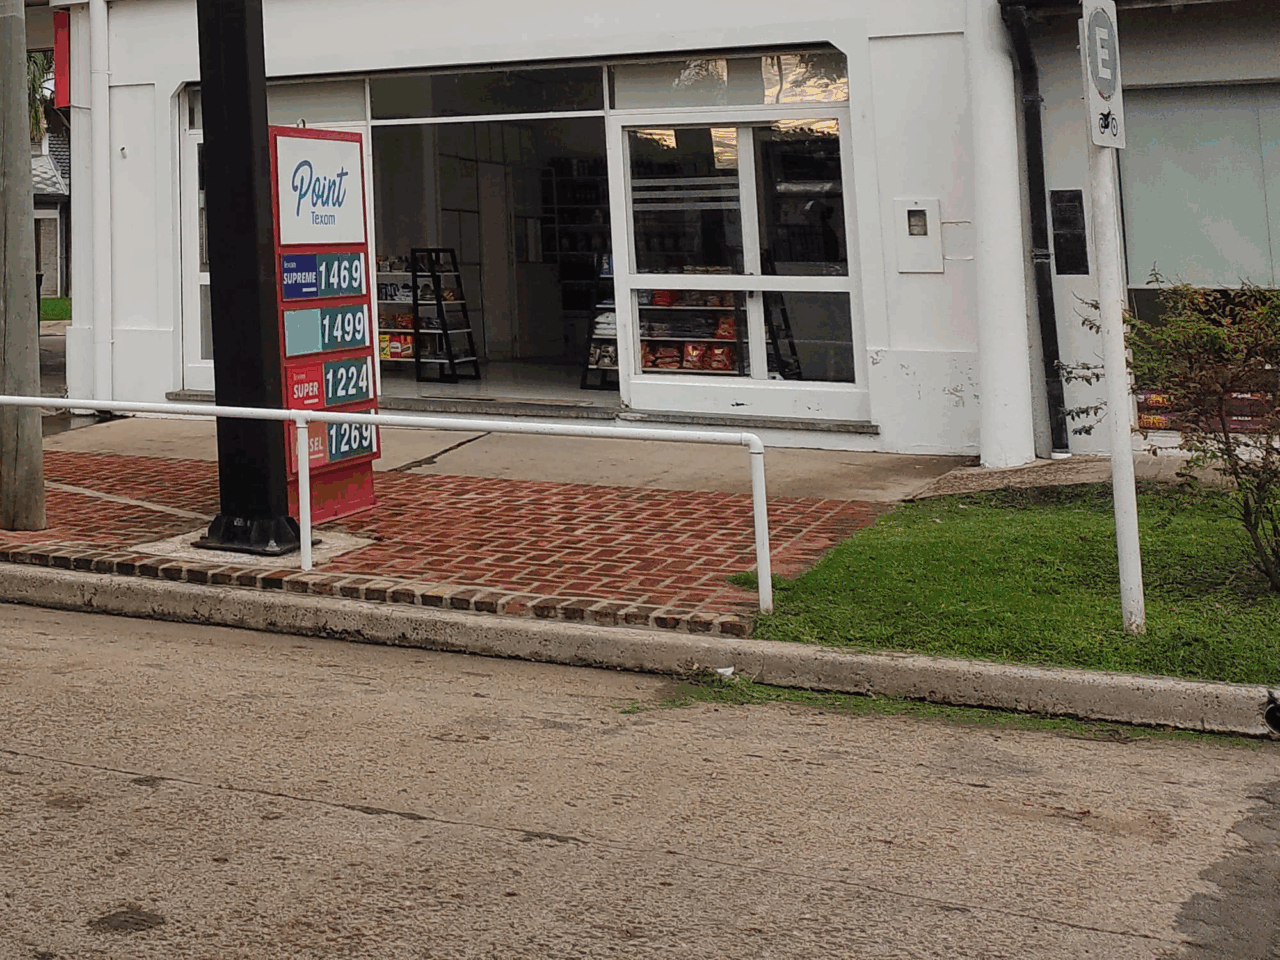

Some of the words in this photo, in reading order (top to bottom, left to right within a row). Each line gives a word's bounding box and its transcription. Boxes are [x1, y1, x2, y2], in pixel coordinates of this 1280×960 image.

[1095, 26, 1112, 80] E
[291, 160, 349, 217] Point
[310, 210, 336, 226] Texom
[283, 271, 317, 284] SUPREME
[319, 259, 361, 290] 1469
[323, 311, 364, 343] 1499
[293, 381, 319, 398] SUPER
[326, 364, 368, 398] 1224
[330, 423, 371, 454] 1269
